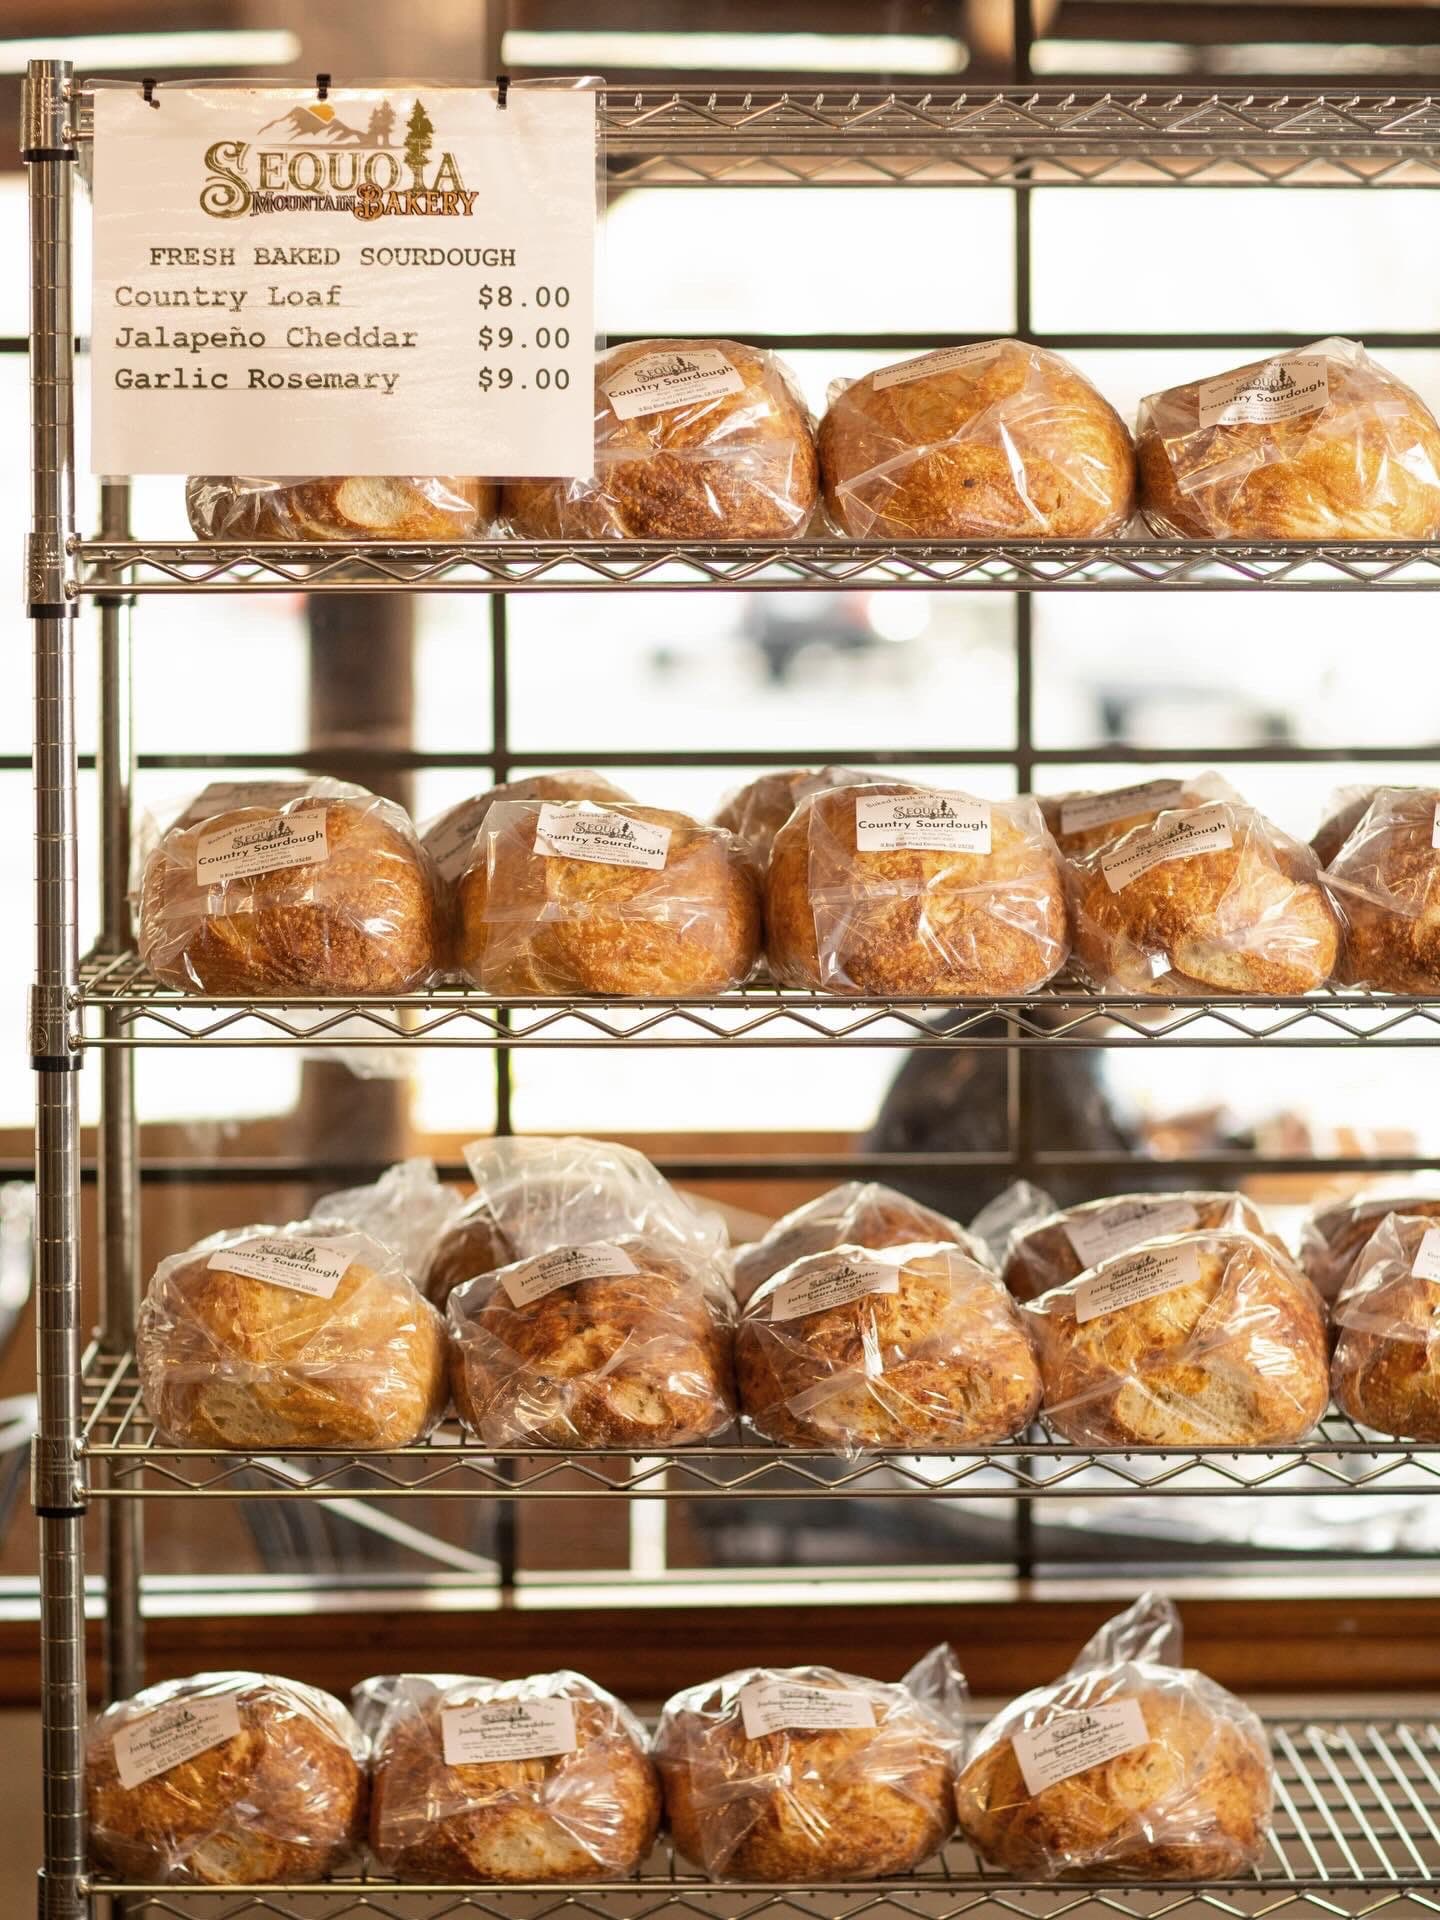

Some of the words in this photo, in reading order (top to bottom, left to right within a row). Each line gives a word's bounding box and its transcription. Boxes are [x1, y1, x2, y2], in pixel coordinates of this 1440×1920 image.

[200, 138, 464, 219] SEQUOIA
[250, 191, 356, 216] MOUNTAIN
[354, 183, 479, 221] BAKERY
[150, 248, 235, 265] FRESH
[254, 248, 340, 265] BAKED
[361, 248, 515, 266] SOURDOUGH
[116, 287, 247, 312] Country
[269, 286, 341, 306] Loaf
[479, 285, 569, 309] $8.00
[116, 327, 265, 352] Jalapeño
[287, 327, 415, 347] Cheddar
[479, 326, 569, 350] $9.00
[115, 368, 228, 389] Garlic
[248, 369, 398, 394] Rosemary
[479, 367, 569, 392] $9.00
[609, 381, 659, 398] Country
[663, 366, 734, 386] Sourdough
[1201, 392, 1251, 412] Country
[1256, 380, 1325, 402] Sourdough
[858, 820, 911, 829] Country
[916, 820, 988, 831] Sourdough
[198, 848, 249, 866] Country
[254, 831, 323, 853] Sourdough
[594, 837, 664, 856] Sourdough
[1103, 848, 1152, 872] Country
[1158, 822, 1226, 848] Sourdough
[272, 1257, 340, 1278] Sourdough
